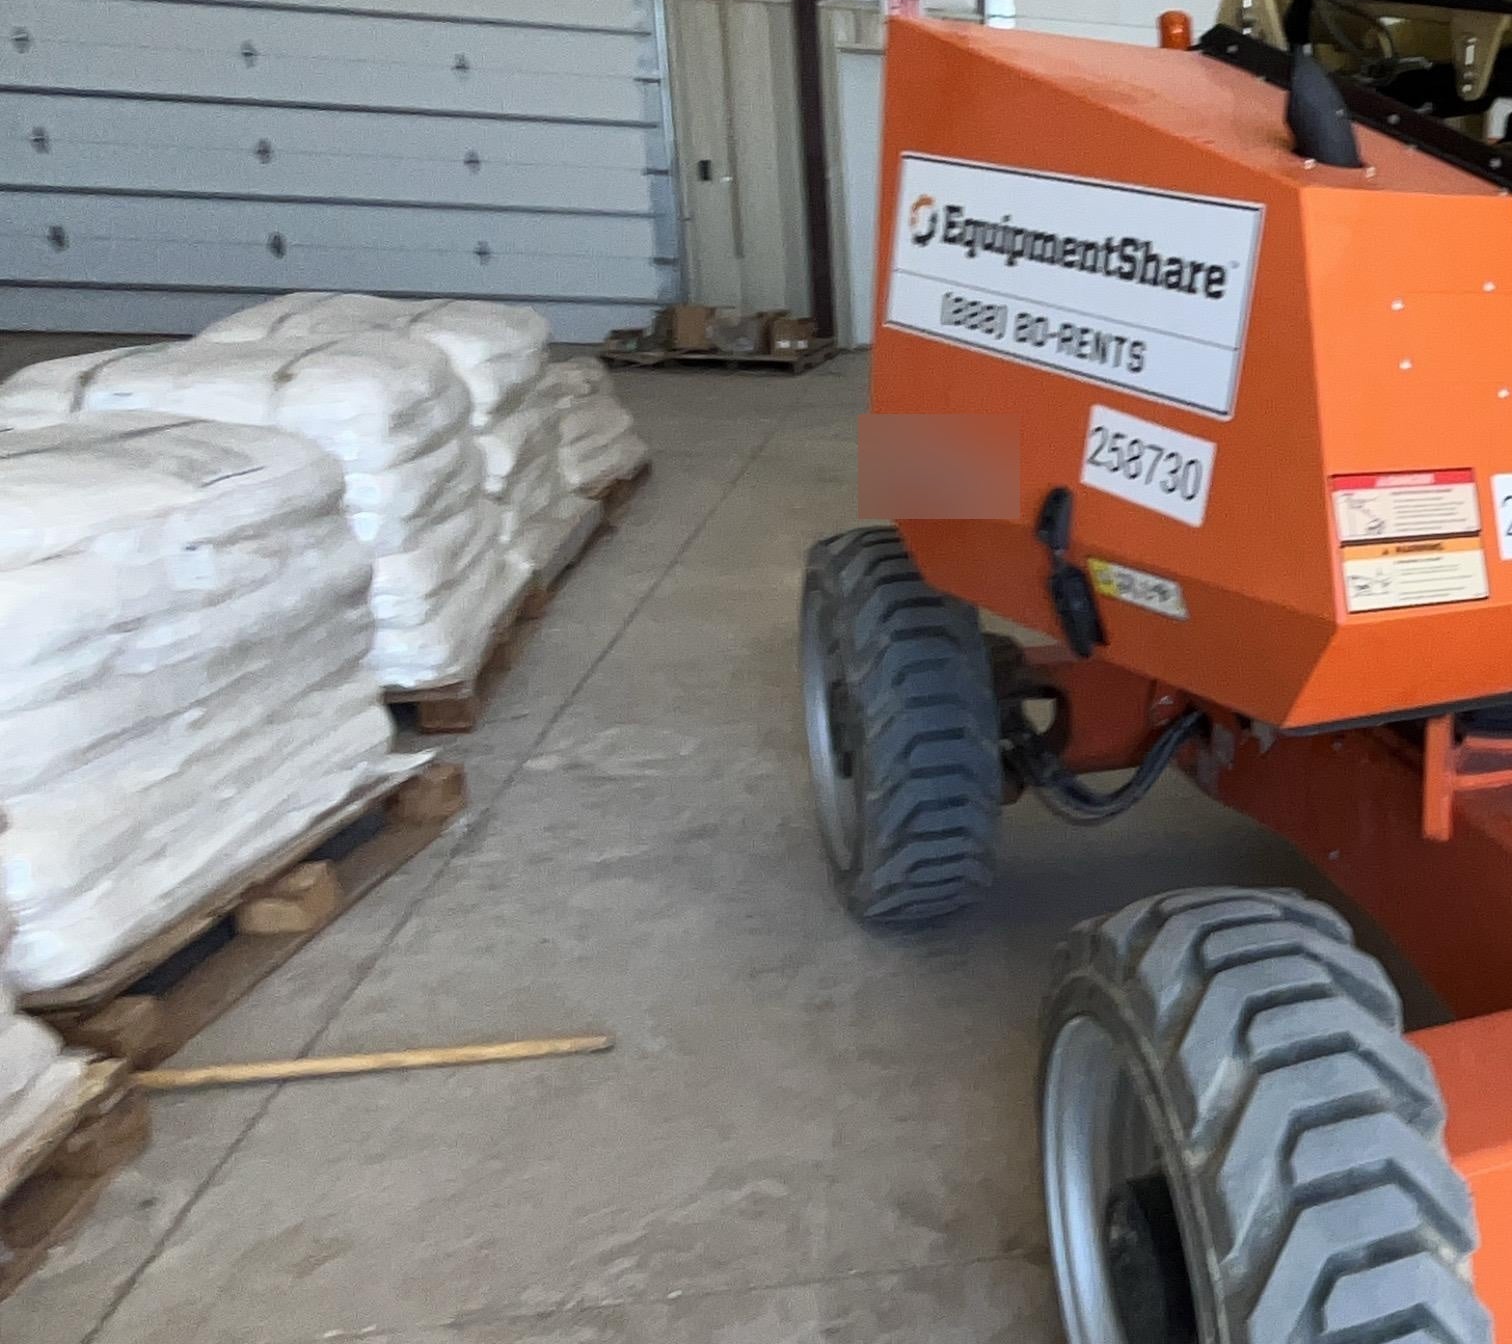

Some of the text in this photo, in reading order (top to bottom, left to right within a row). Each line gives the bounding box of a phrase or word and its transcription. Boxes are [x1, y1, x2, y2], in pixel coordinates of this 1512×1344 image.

[942, 205, 1226, 299] EquipmentShare
[941, 292, 1147, 373] (888) 80-RENTS
[1087, 425, 1203, 501] 258730
